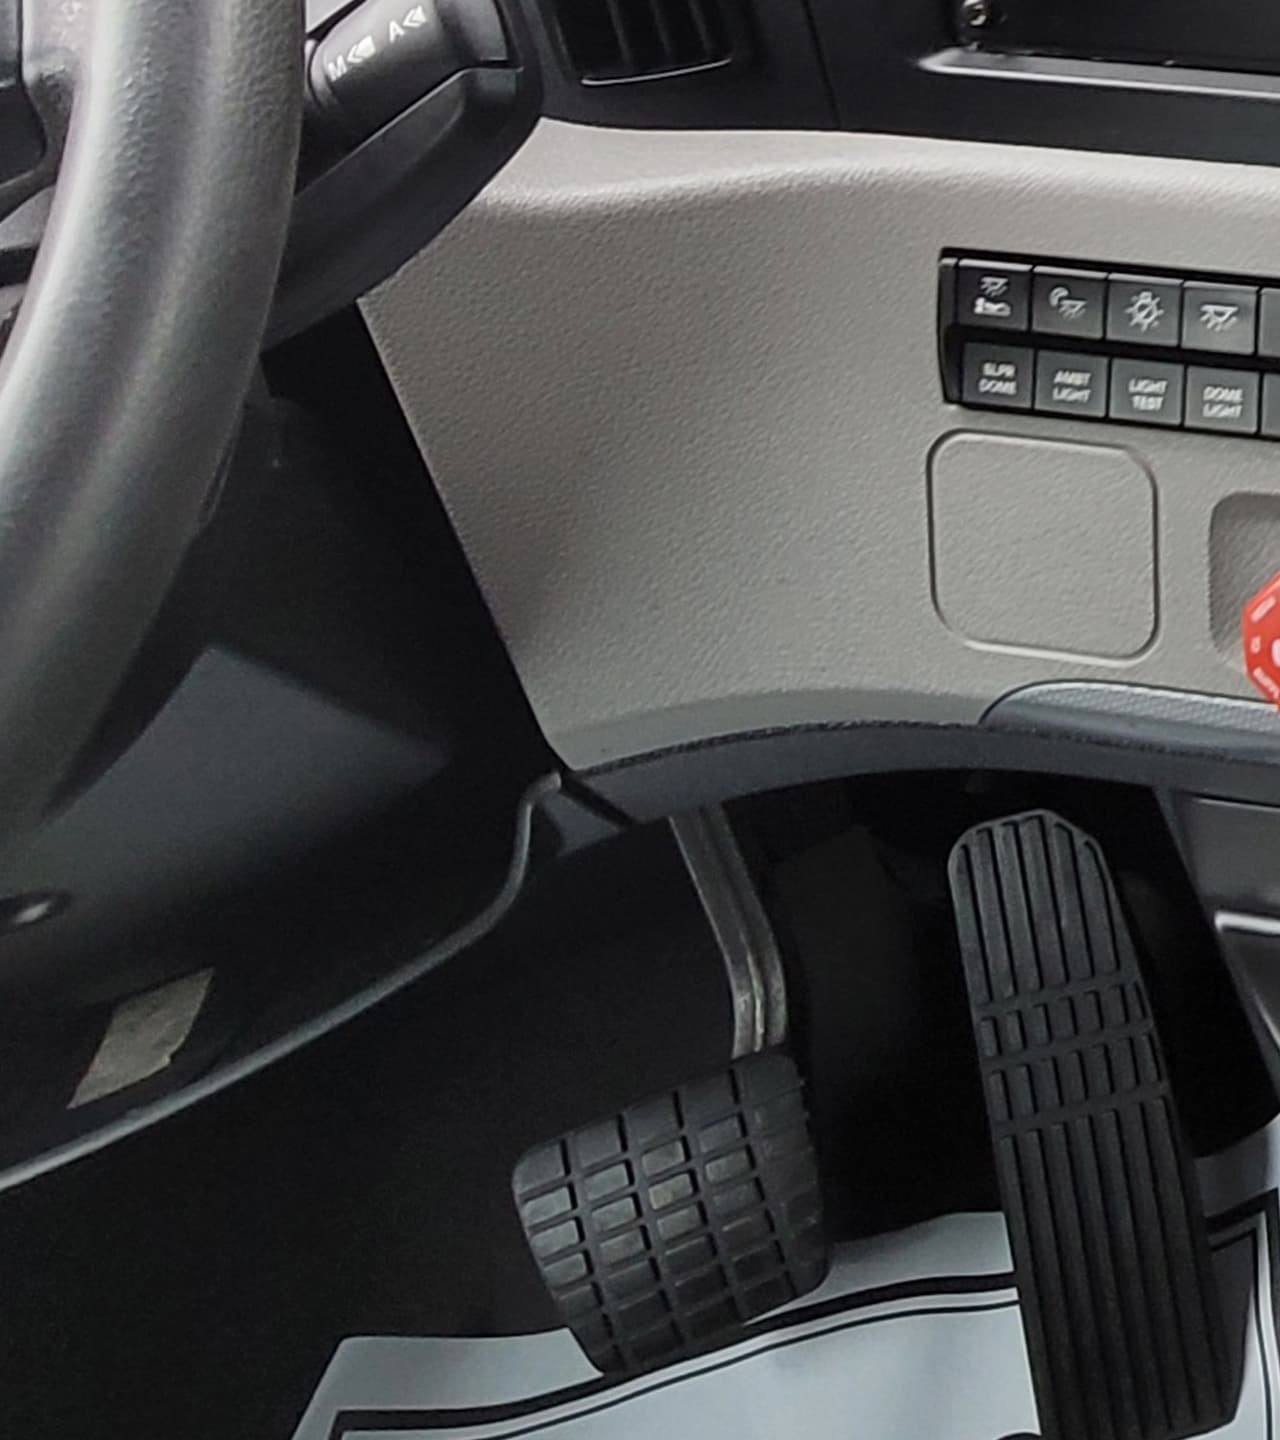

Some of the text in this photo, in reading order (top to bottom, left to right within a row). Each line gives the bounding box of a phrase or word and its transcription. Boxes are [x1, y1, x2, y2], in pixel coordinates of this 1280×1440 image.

[1128, 378, 1168, 394] LIGHT
[1053, 387, 1091, 404] LIGHT
[1203, 386, 1244, 403] DOME
[1132, 395, 1163, 411] TEST
[1202, 403, 1242, 419] LIGHT
